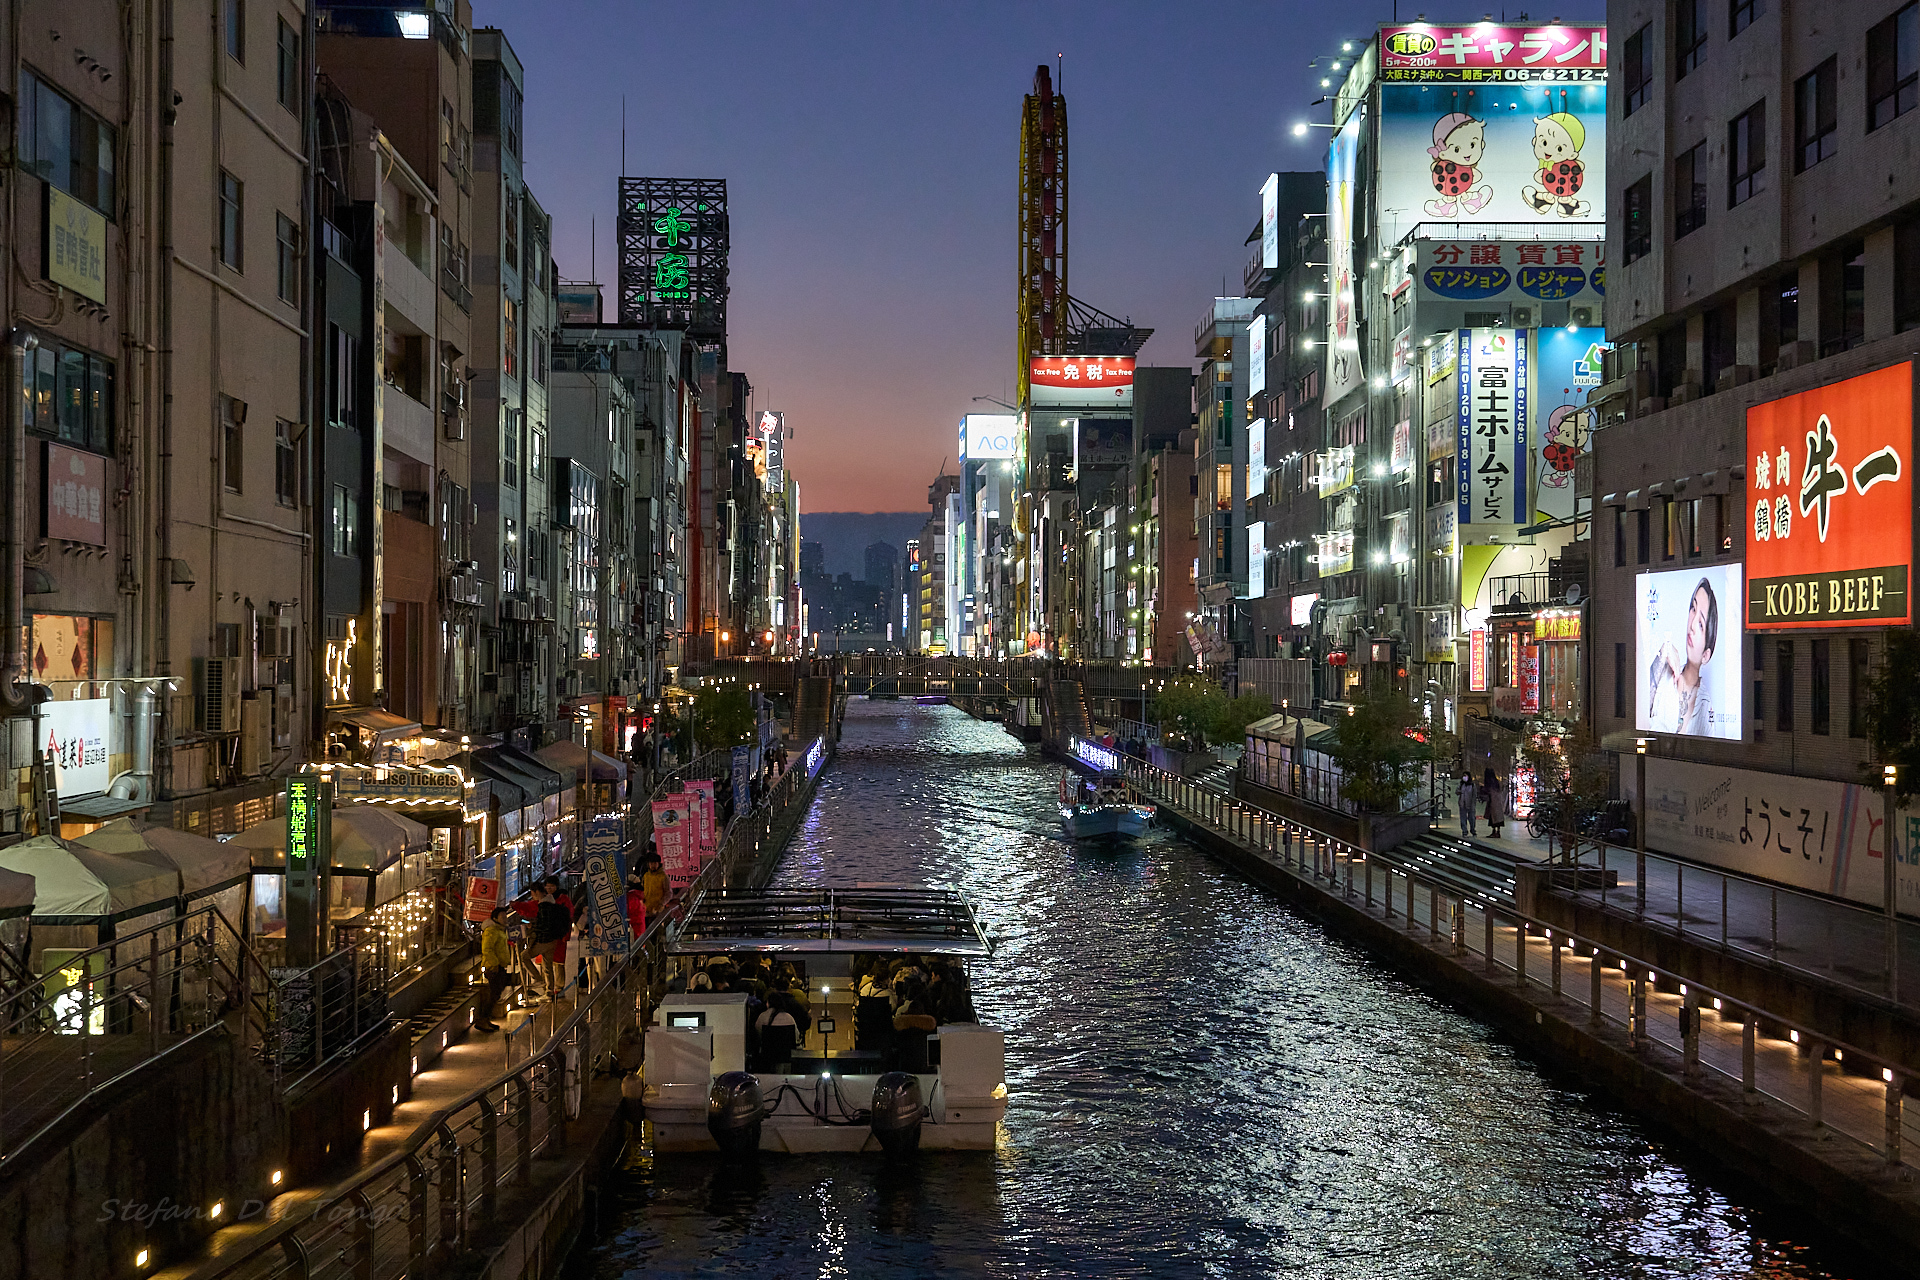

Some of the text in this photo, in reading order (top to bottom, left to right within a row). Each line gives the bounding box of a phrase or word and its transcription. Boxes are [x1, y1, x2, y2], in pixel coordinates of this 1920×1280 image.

[1393, 35, 1434, 52] 賃貸の
[1432, 245, 1502, 264] 分譲
[1516, 244, 1584, 264] 賃貸
[1430, 270, 1507, 289] マンション
[1522, 270, 1584, 288] レジャー
[1540, 288, 1566, 298] ビル
[1476, 365, 1509, 519] 富士ホームサービス
[1755, 445, 1791, 490] 焼肉
[1754, 494, 1791, 542] 鶴橋
[1764, 575, 1884, 617] KOBE BEEF
[409, 771, 458, 787] Tickets
[605, 852, 624, 898] WONDER
[481, 884, 488, 895] 3
[585, 855, 625, 942] CRUISE
